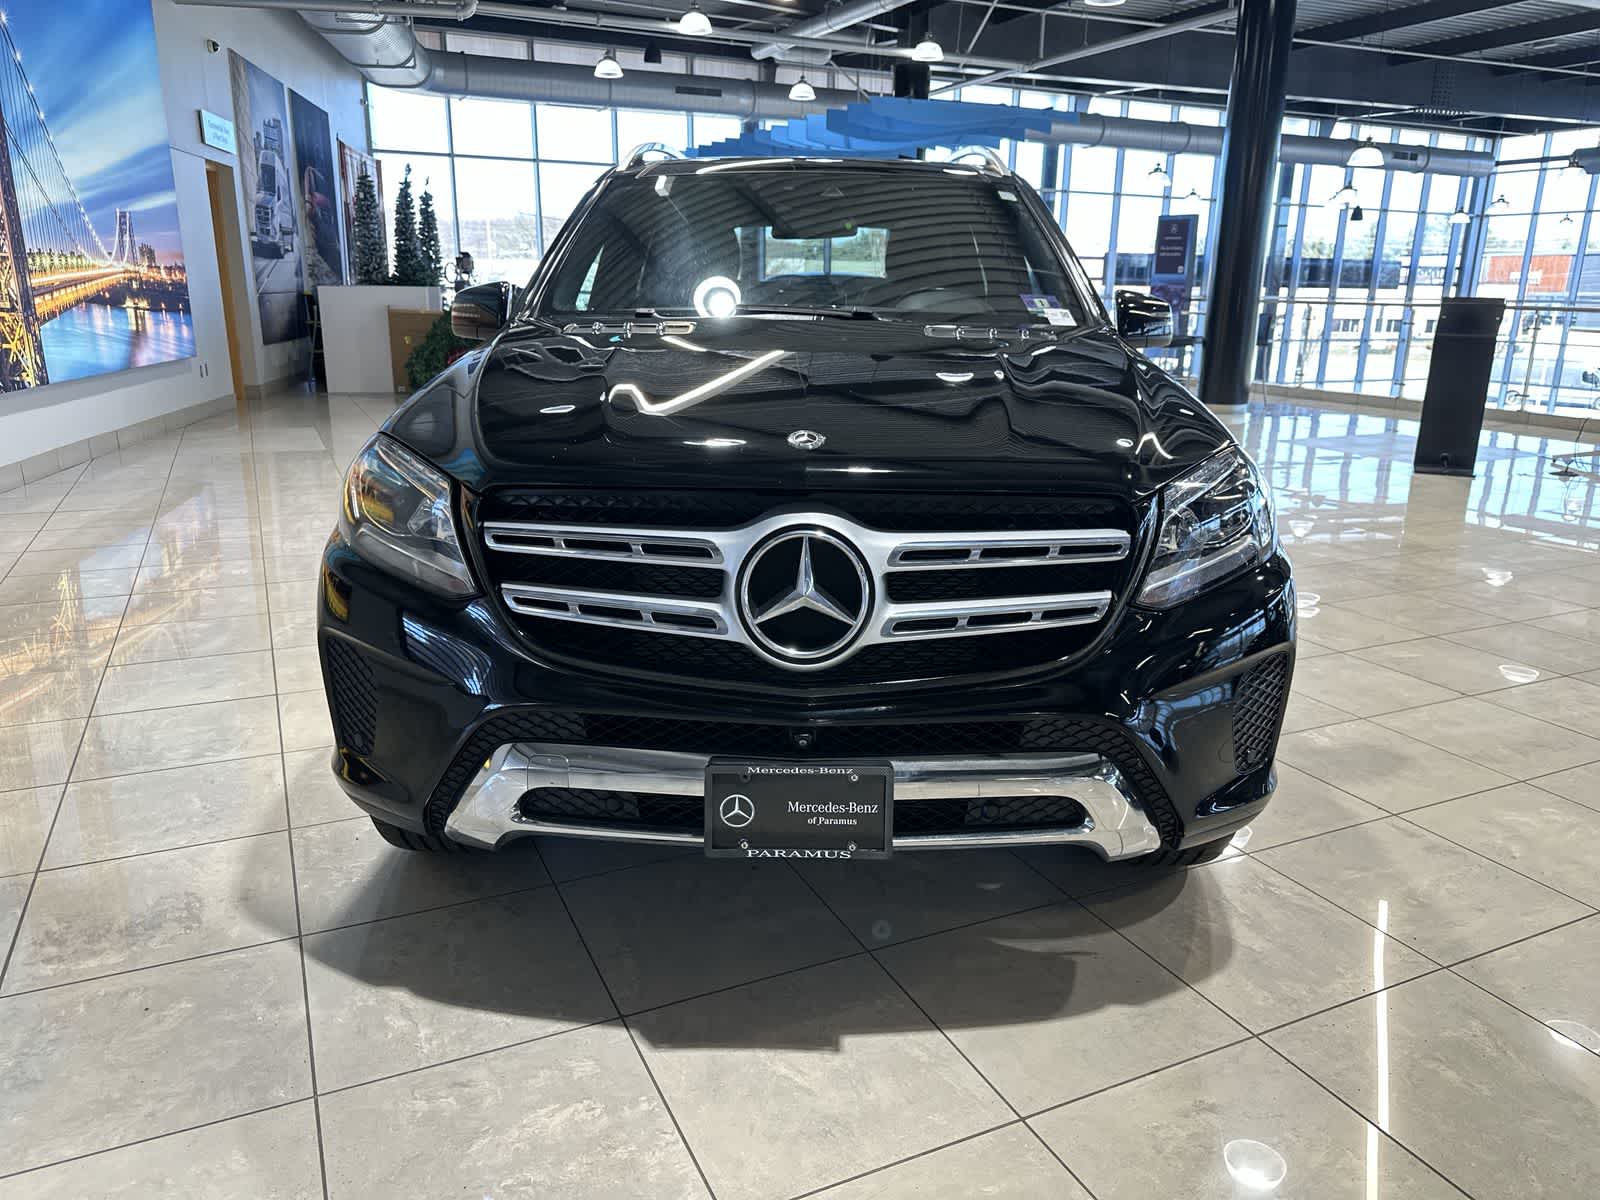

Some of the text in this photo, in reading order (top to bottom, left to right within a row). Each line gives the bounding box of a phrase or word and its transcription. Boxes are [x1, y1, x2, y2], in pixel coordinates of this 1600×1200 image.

[747, 766, 853, 775] Mercedes-Benz
[787, 801, 879, 814] Mercedes-Benz
[807, 817, 858, 827] of Paramus
[746, 850, 852, 859] PARAMUS
